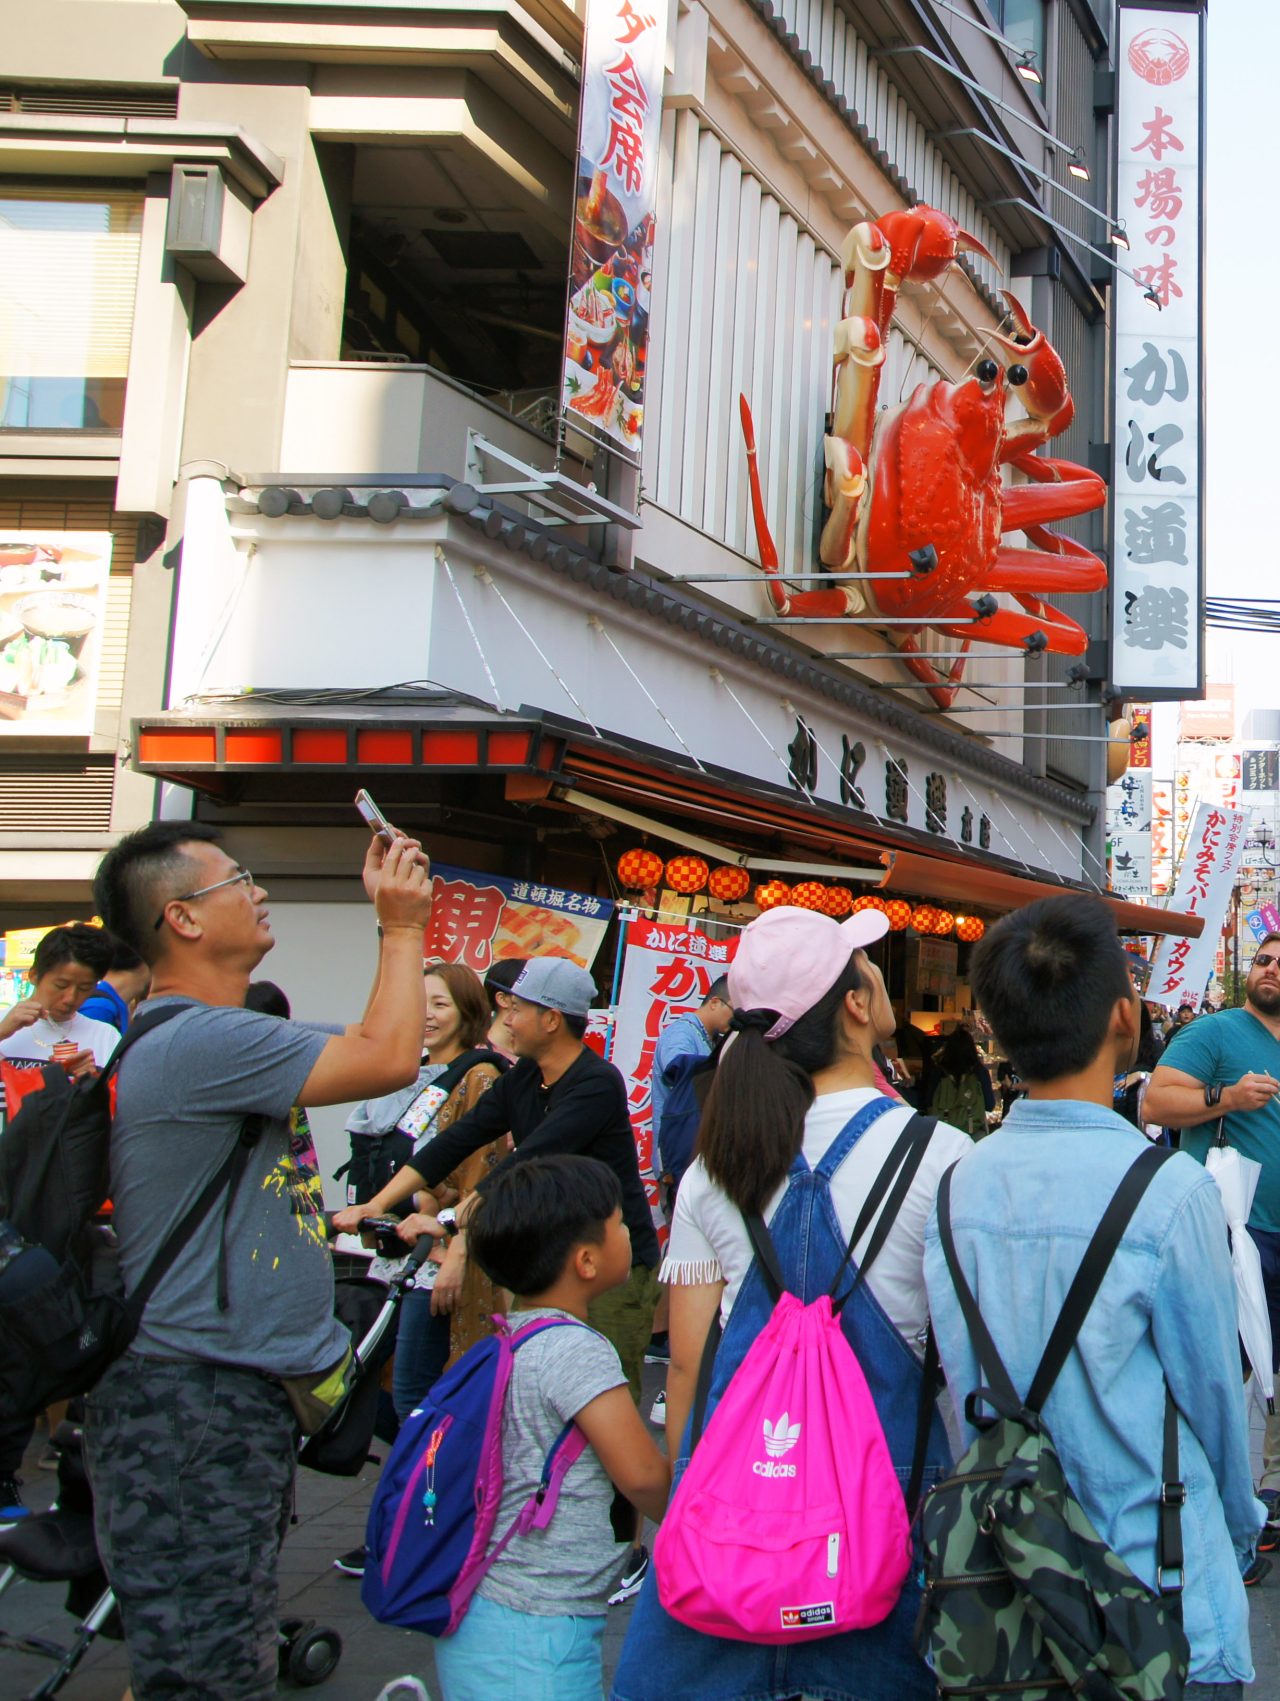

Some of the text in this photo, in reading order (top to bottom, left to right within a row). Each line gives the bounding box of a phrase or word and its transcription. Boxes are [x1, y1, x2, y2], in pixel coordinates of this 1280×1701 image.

[1130, 105, 1185, 307] 本場の味
[511, 882, 601, 915] 道頓堀名物
[752, 1460, 797, 1478] adidas
[800, 1606, 831, 1618] adidas
